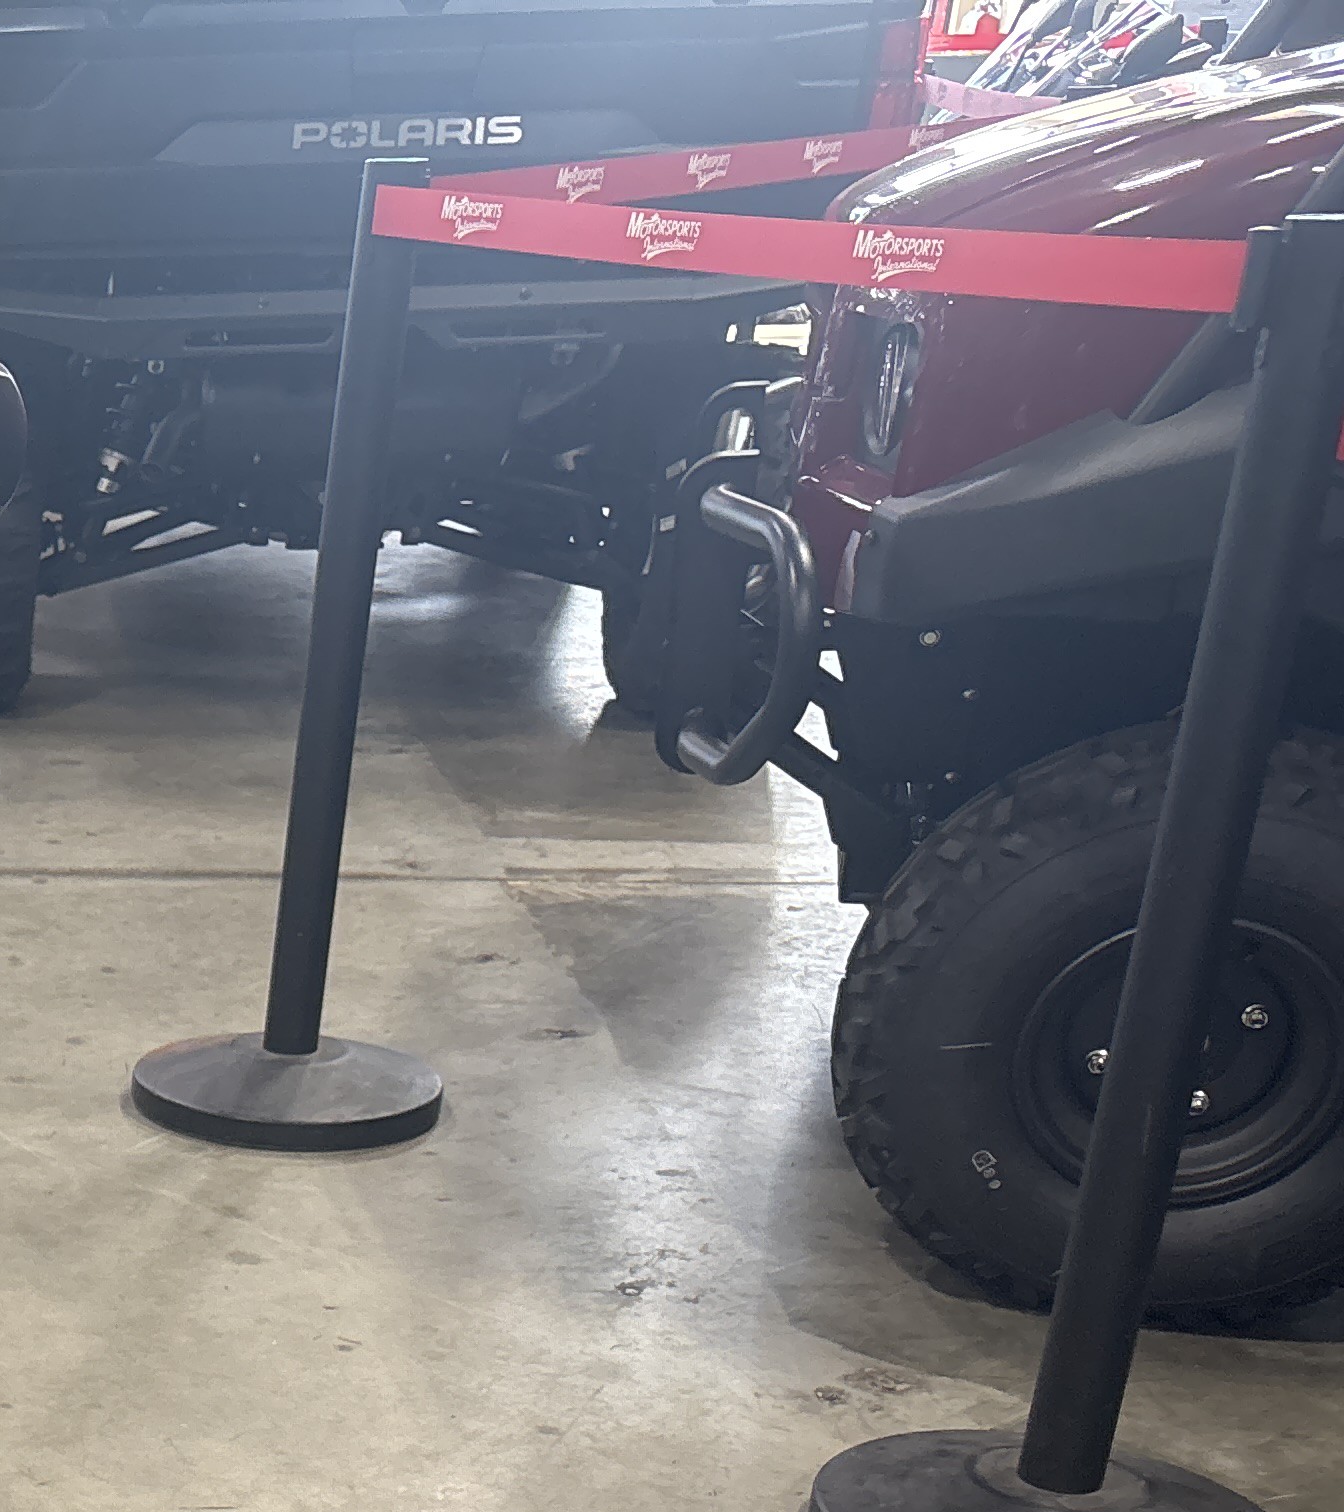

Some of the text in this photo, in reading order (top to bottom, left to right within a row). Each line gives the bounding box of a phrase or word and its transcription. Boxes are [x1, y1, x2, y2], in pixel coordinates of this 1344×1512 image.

[292, 115, 523, 149] POLARIS
[626, 212, 702, 238] MOTORSPORTS
[852, 230, 945, 259] MOTORSPORTS
[871, 256, 940, 280] International
